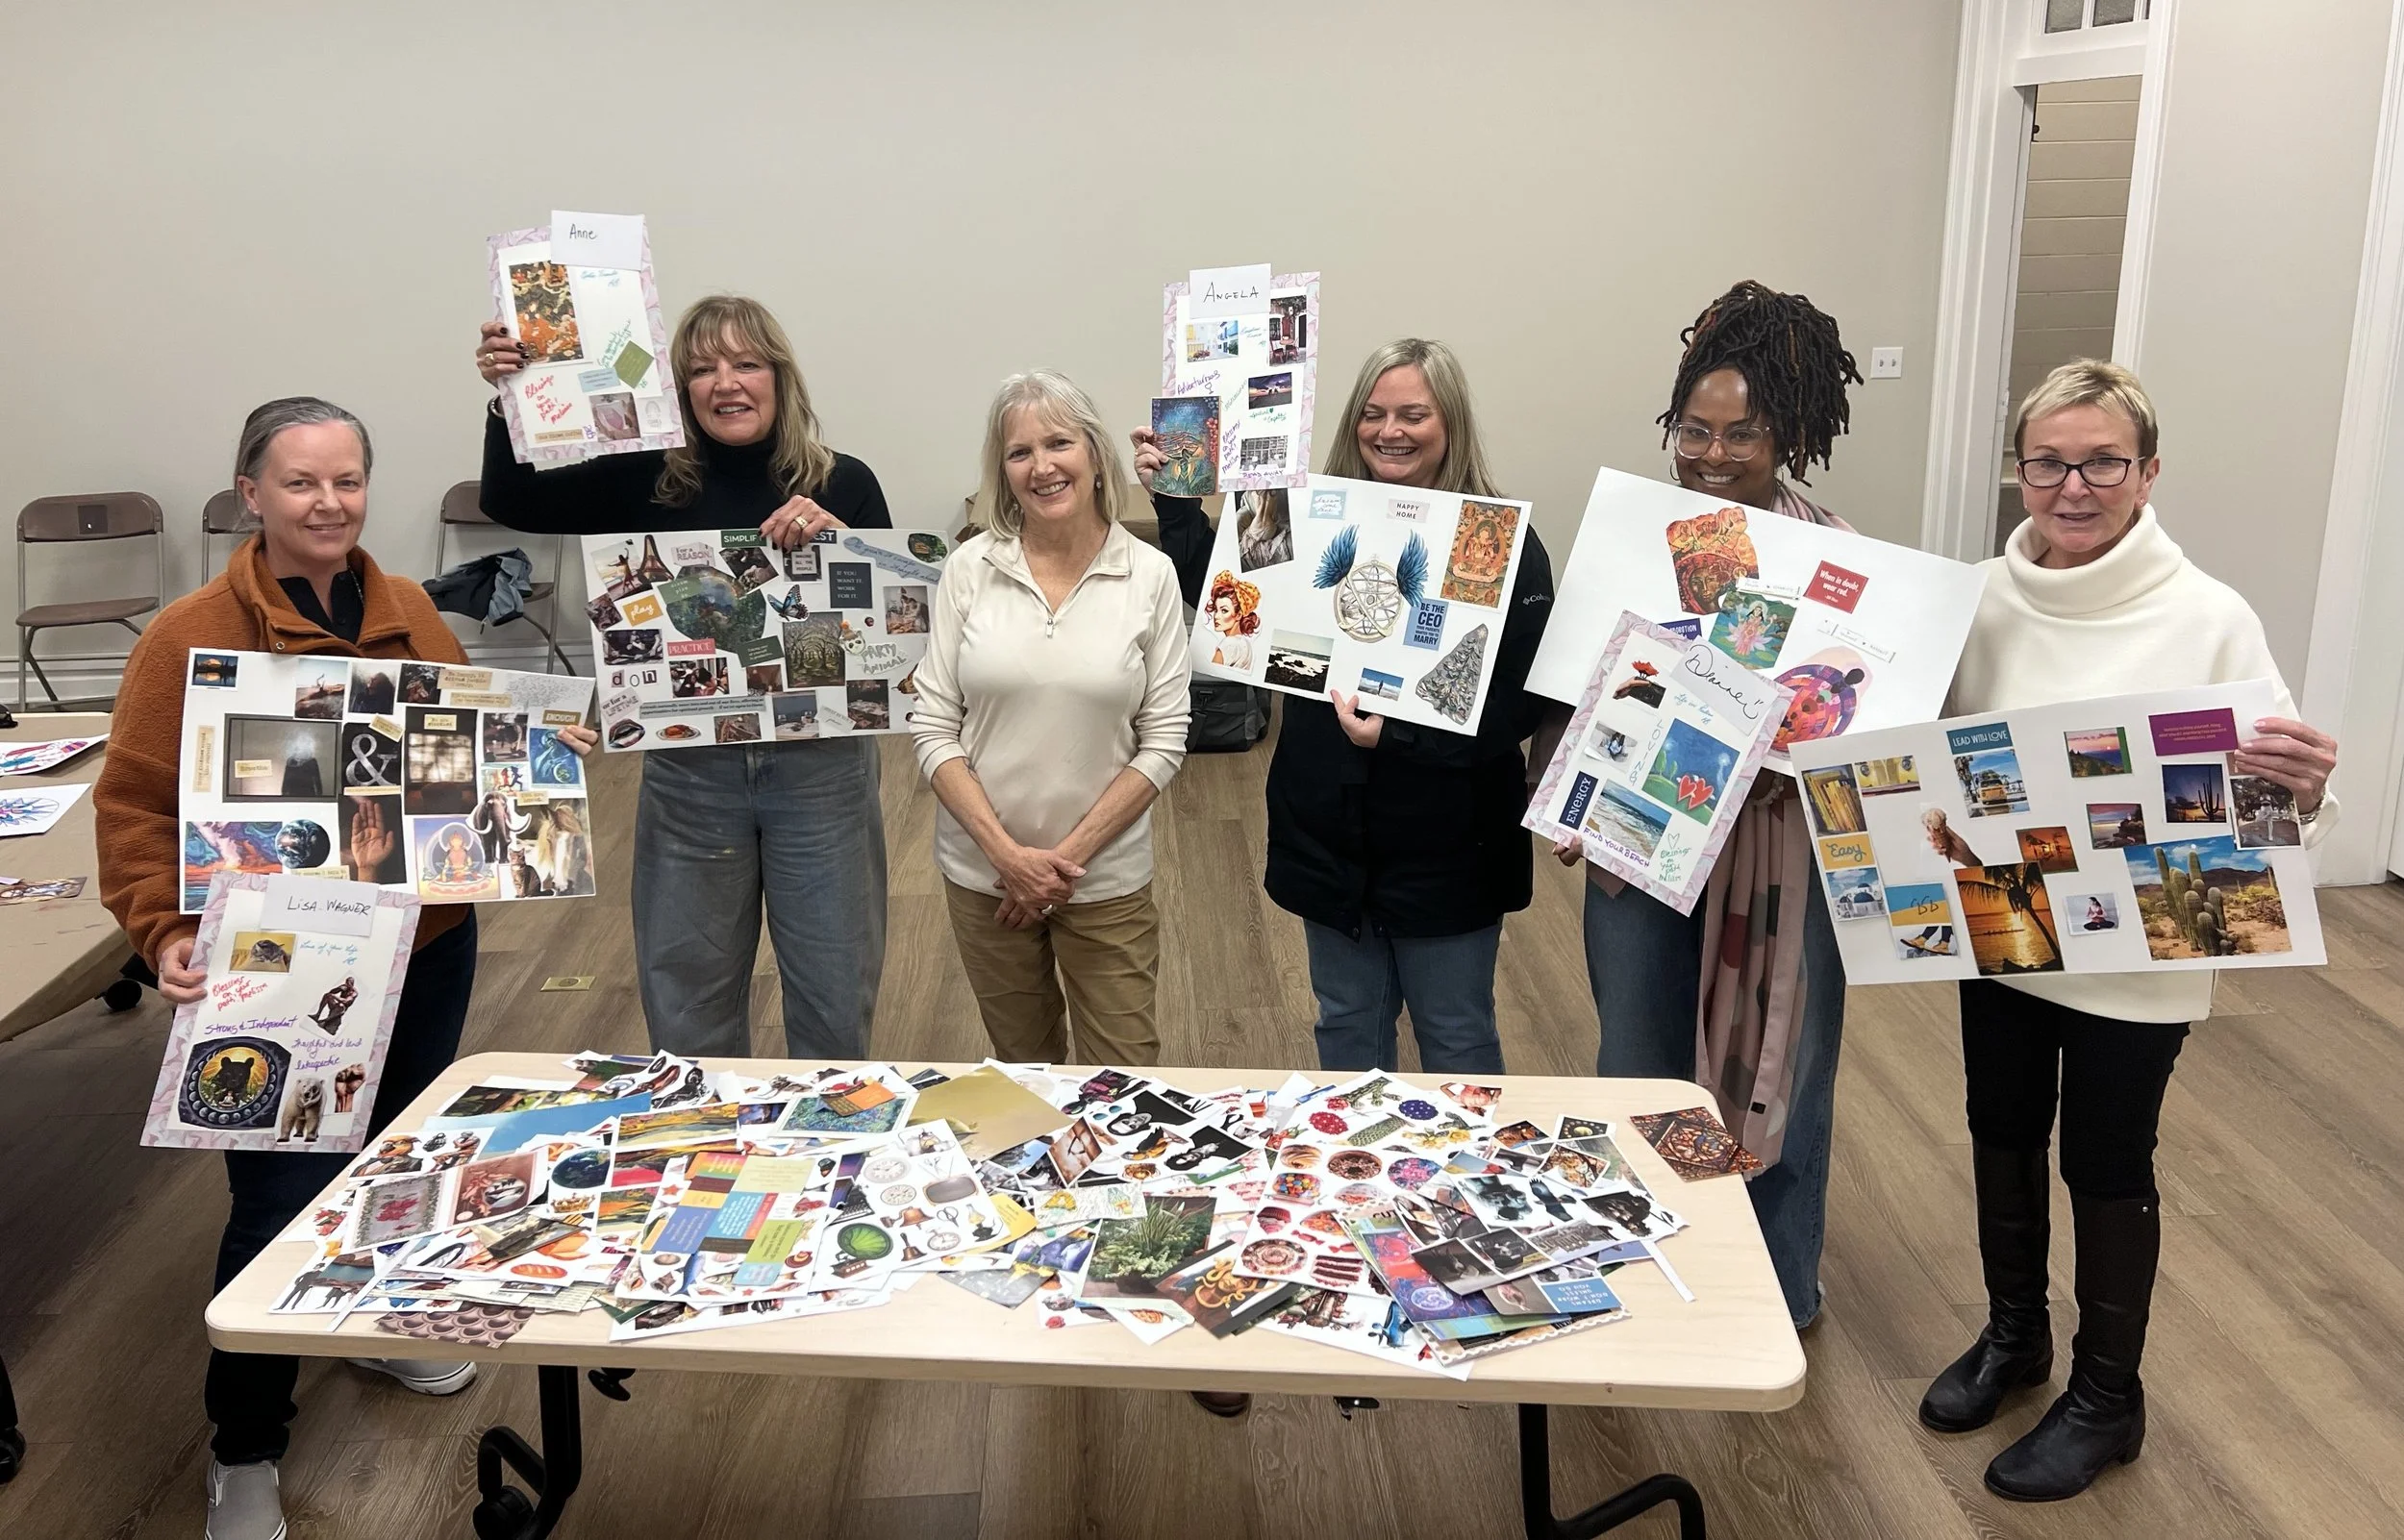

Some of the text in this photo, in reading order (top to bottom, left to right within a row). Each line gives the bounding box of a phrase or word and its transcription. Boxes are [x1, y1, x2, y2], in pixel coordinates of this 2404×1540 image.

[569, 224, 597, 240] Anne
[1203, 281, 1259, 303] ANGELA
[1396, 503, 1419, 511] HAPPY
[1396, 511, 1416, 520] HOME
[1819, 569, 1860, 592] When in doubt,
[1822, 583, 1849, 597] wear red.
[630, 604, 655, 620] play
[1420, 603, 1445, 614] BE THE
[1417, 611, 1442, 628] CEO
[1414, 633, 1438, 644] MARRY
[669, 642, 713, 655] PRACTICE
[863, 644, 897, 662] PARTY
[1953, 730, 2009, 748] LEAD WITH LOVE
[1583, 827, 1651, 868] FIND YOUR BEACH
[1826, 841, 1867, 863] Easy
[327, 900, 371, 916] WAGNER
[204, 1023, 238, 1035] Strong
